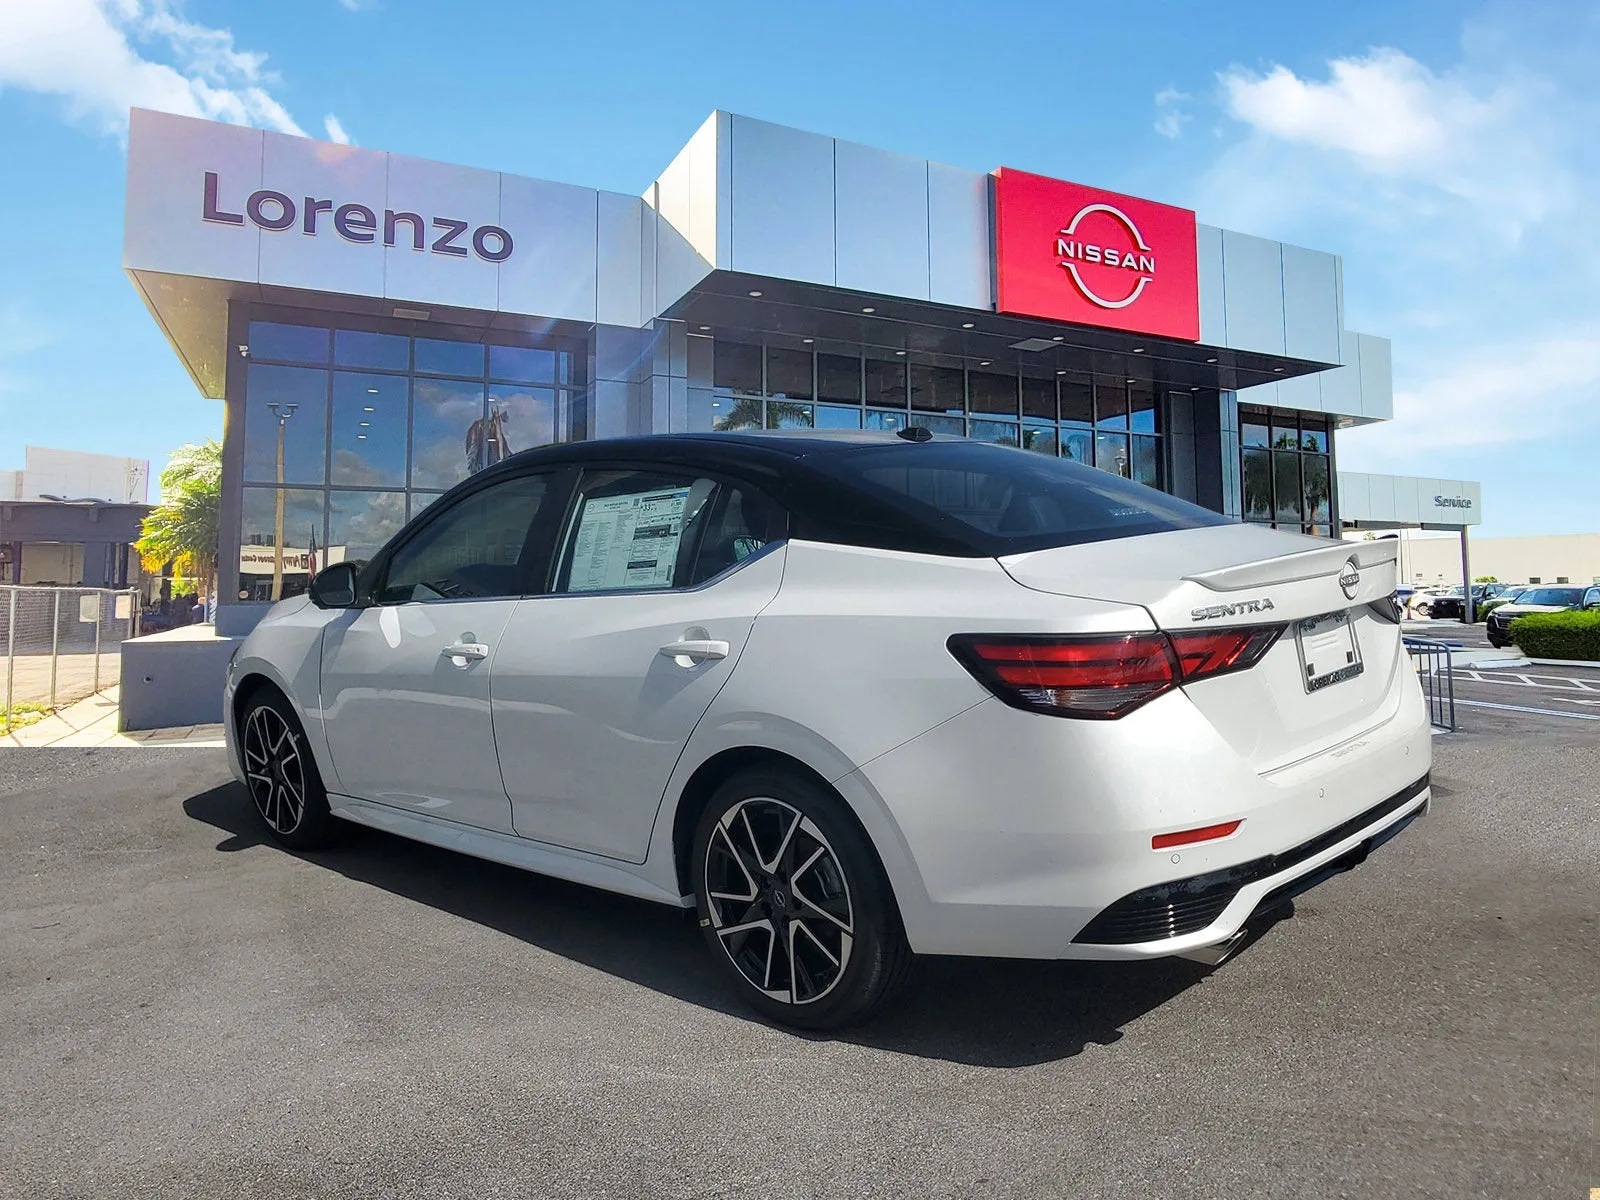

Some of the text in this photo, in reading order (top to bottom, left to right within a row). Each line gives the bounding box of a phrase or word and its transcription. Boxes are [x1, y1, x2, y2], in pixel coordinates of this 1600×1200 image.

[203, 170, 514, 263] Lorenzo
[1057, 238, 1155, 274] NISSAN
[1434, 495, 1472, 509] Service
[1340, 574, 1359, 586] NISS
[1191, 598, 1275, 622] SENTRA
